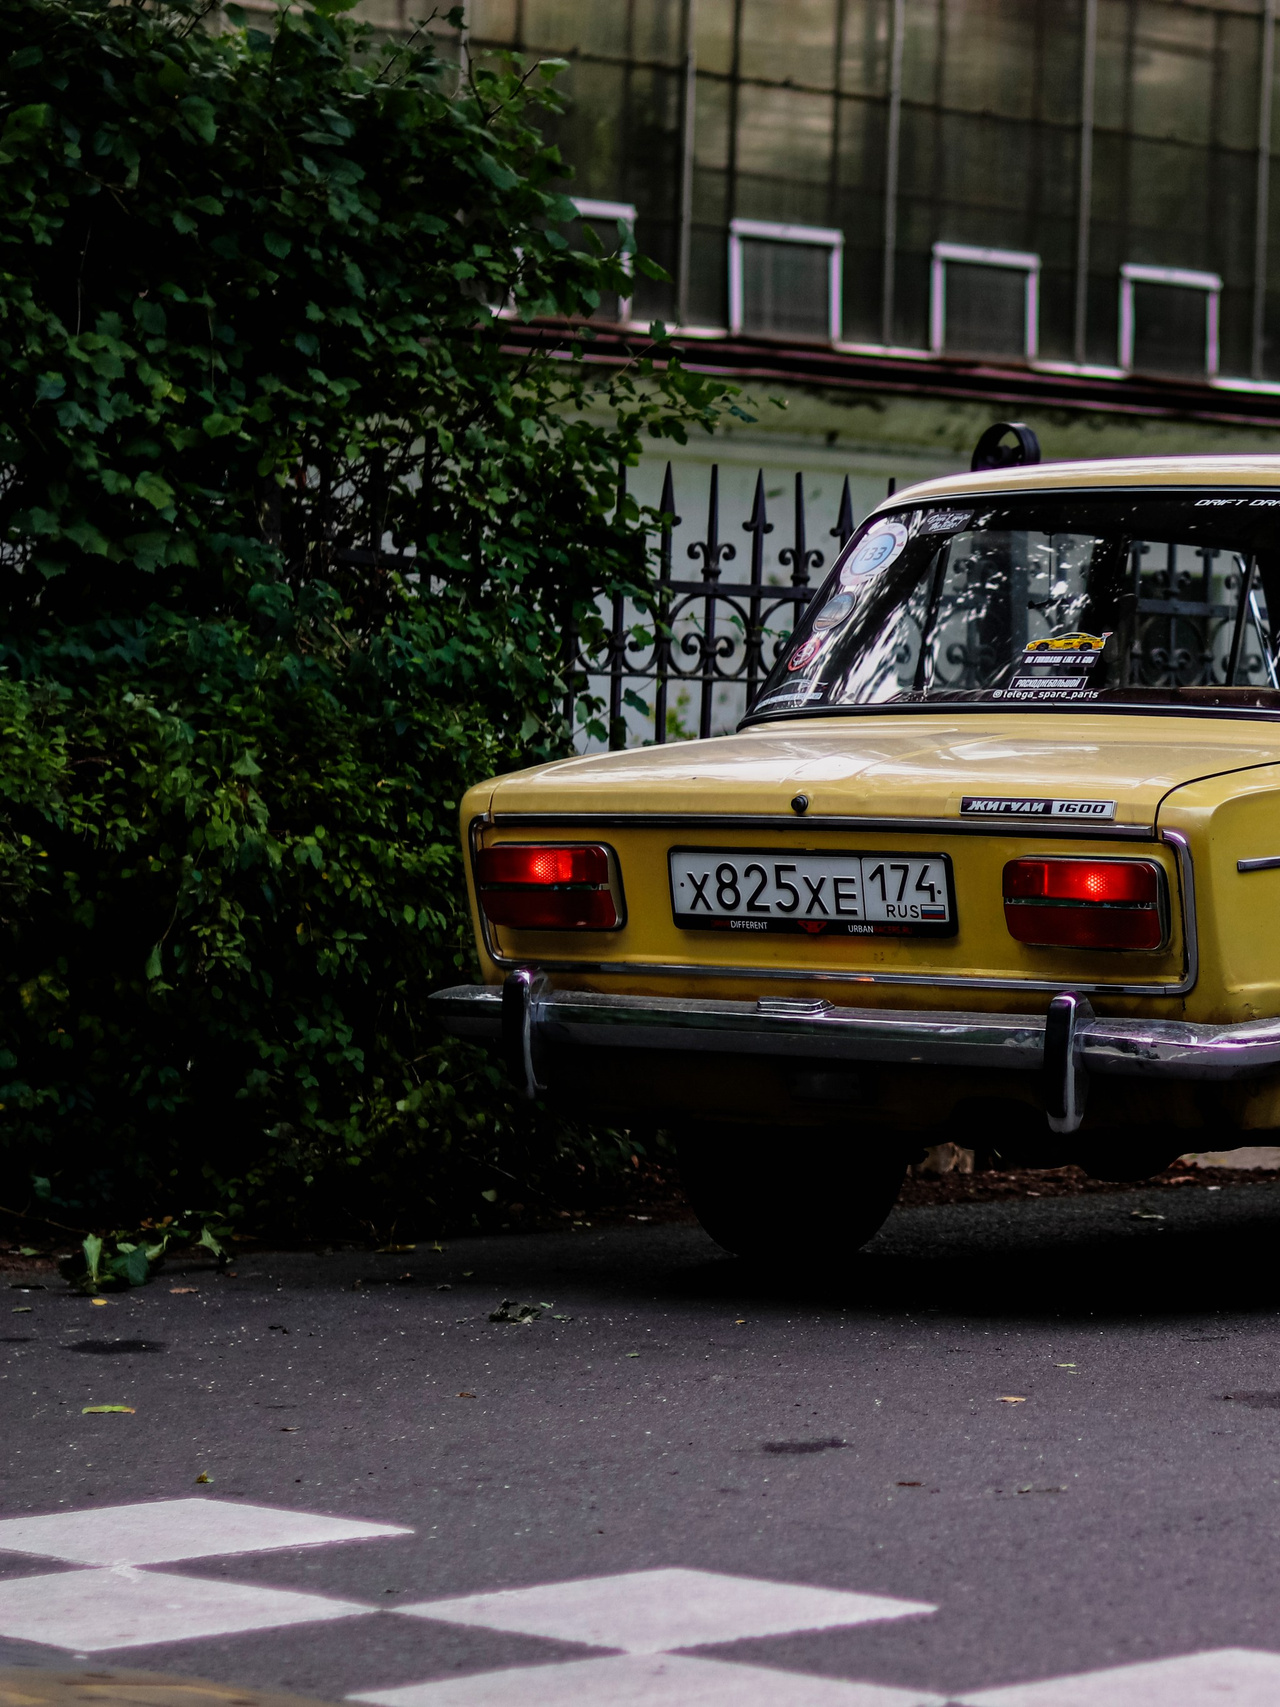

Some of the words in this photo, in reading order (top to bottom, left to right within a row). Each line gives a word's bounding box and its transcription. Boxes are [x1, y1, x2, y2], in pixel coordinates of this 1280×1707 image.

[1194, 498, 1248, 506] DRIFT
[859, 546, 888, 561] 133
[992, 689, 1099, 700] @telega_spare_parts
[967, 800, 1046, 812] ЖИГУЛИ
[1058, 803, 1106, 814] 1600
[868, 862, 937, 903] 174
[886, 904, 920, 919] RUS
[730, 920, 768, 930] DIFFERENT
